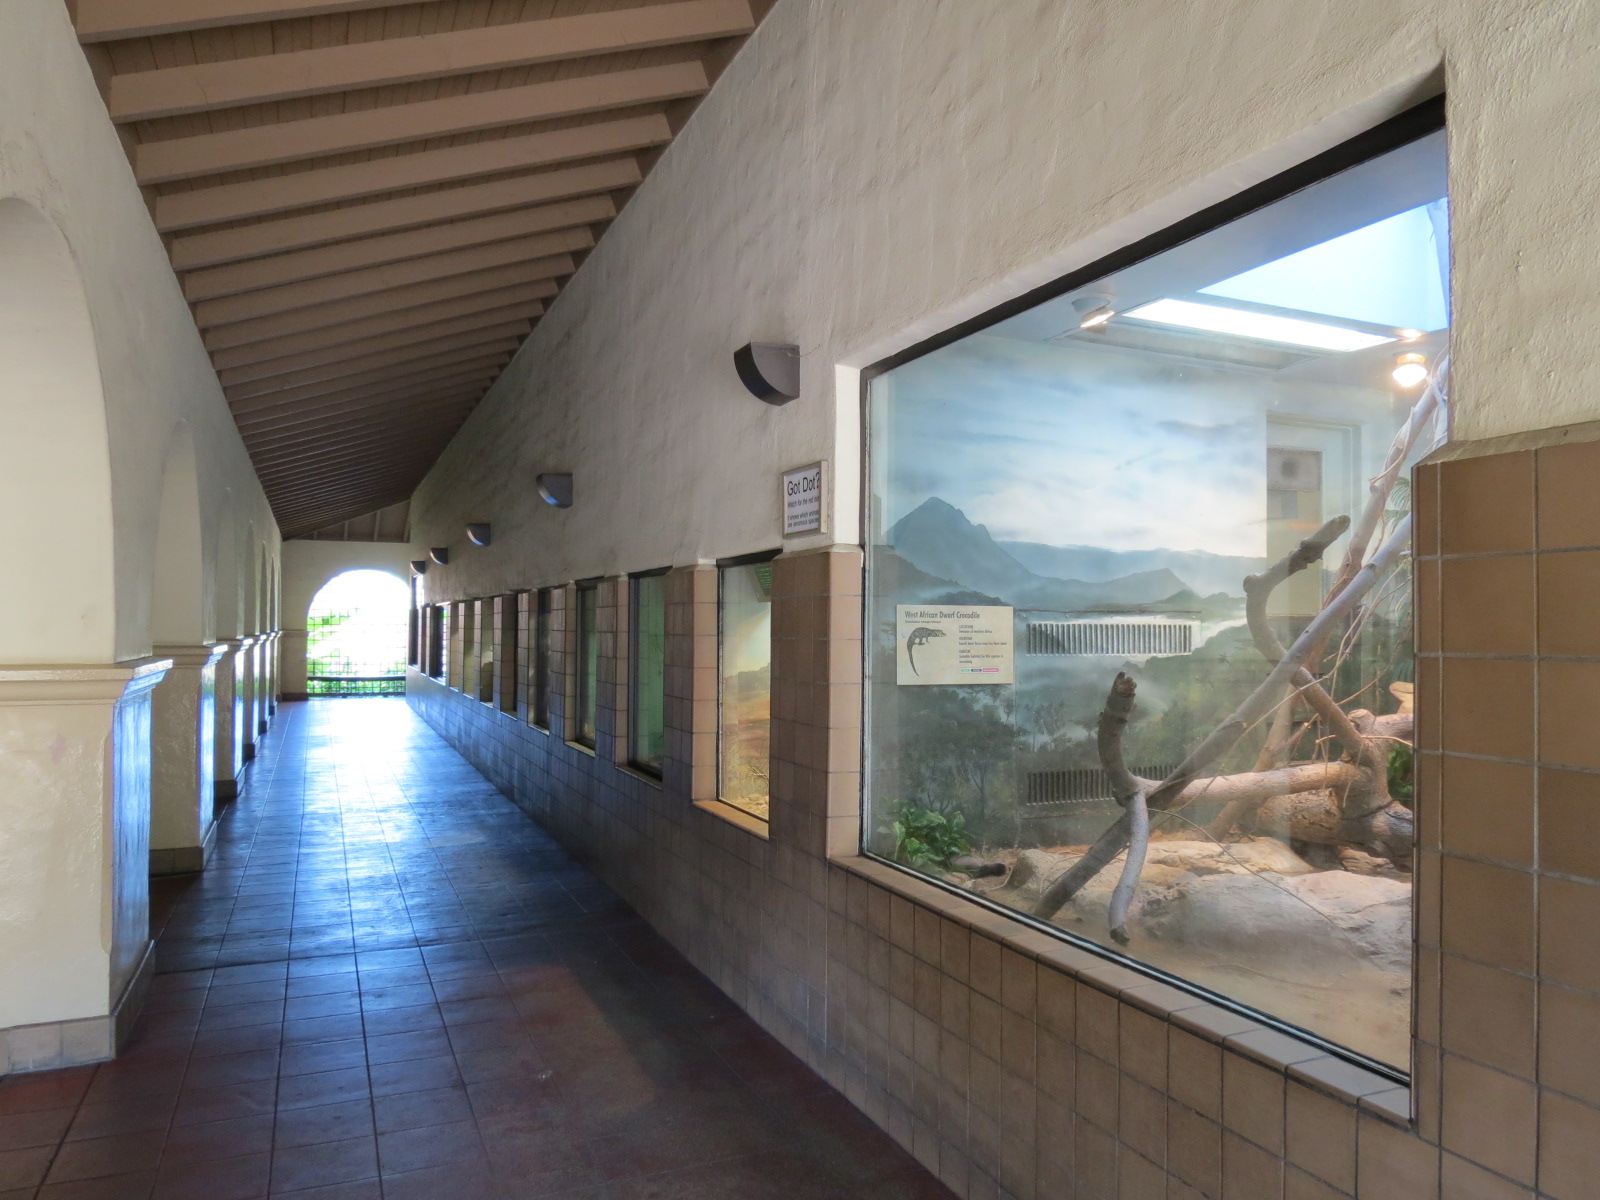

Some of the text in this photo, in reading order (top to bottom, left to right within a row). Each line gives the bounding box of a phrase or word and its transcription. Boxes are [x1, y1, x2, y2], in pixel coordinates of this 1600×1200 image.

[788, 472, 820, 496] Got Dot?
[905, 611, 918, 619] West
[957, 611, 980, 619] Crocodile
